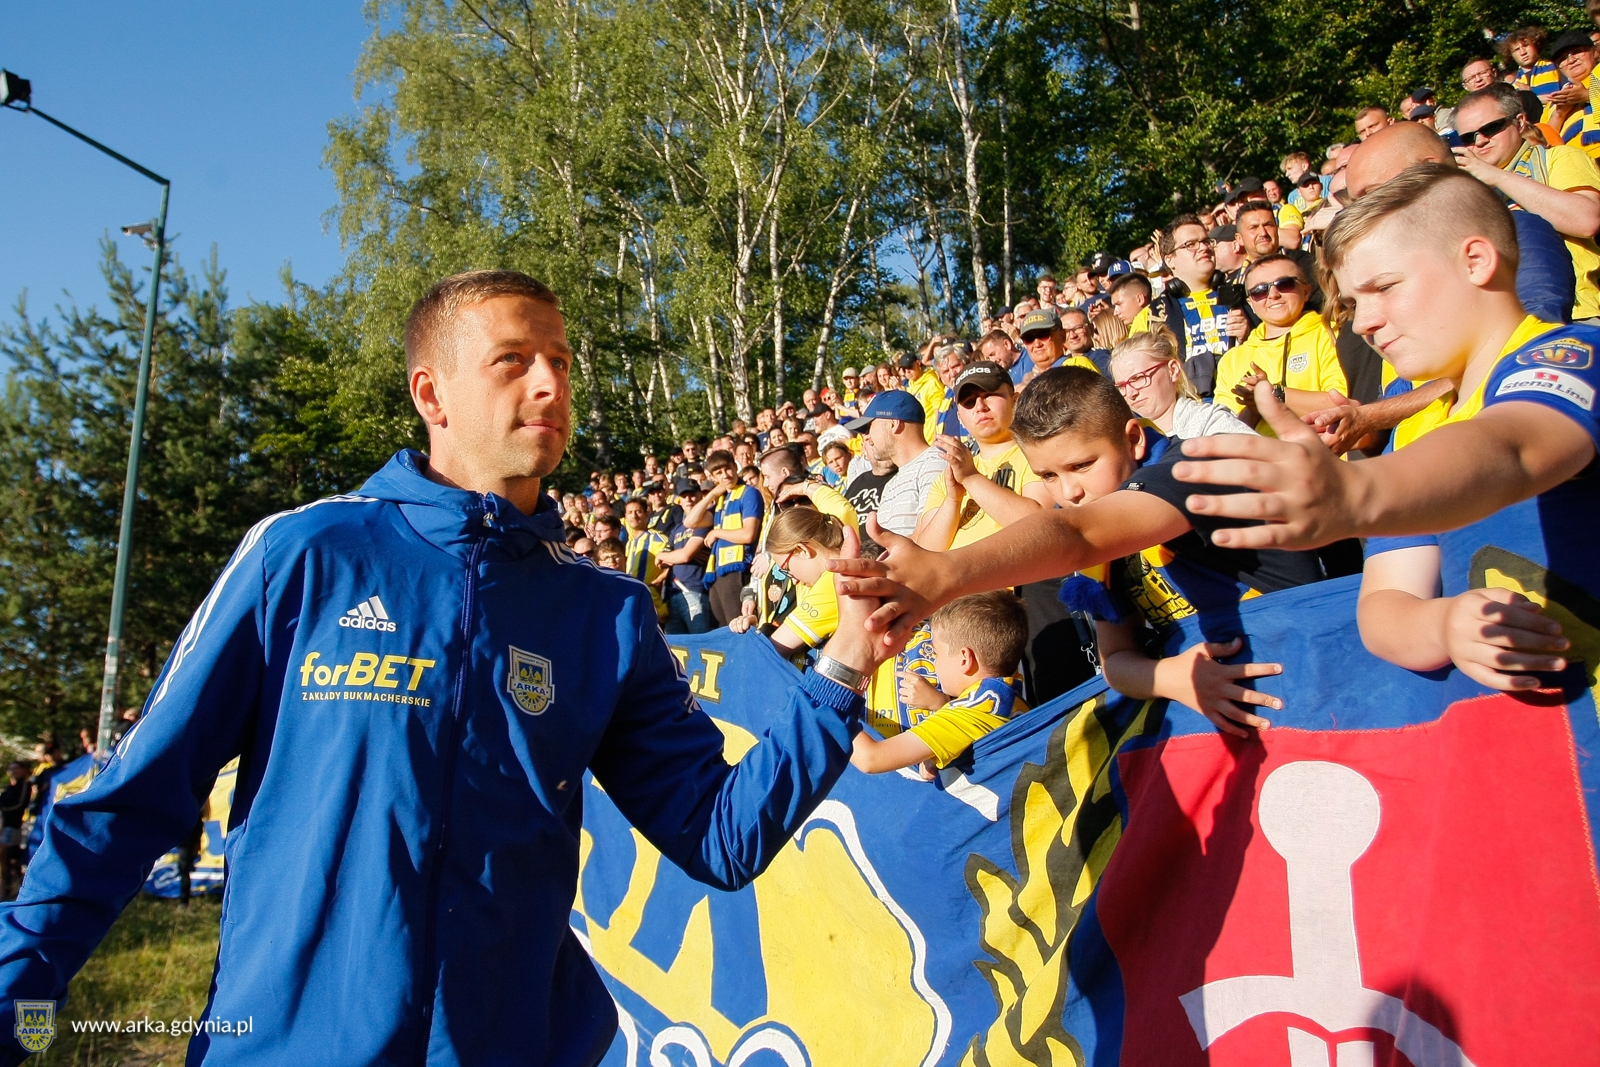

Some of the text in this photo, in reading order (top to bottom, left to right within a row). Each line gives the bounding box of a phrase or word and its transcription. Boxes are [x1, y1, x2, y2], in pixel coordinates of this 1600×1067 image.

[955, 366, 991, 386] adidas
[1555, 383, 1589, 405] Line
[338, 616, 397, 632] adidas
[300, 651, 436, 691] forBET
[516, 682, 546, 696] ARKA
[301, 691, 431, 708] ZAKŁADY BUKMACHERSKIE
